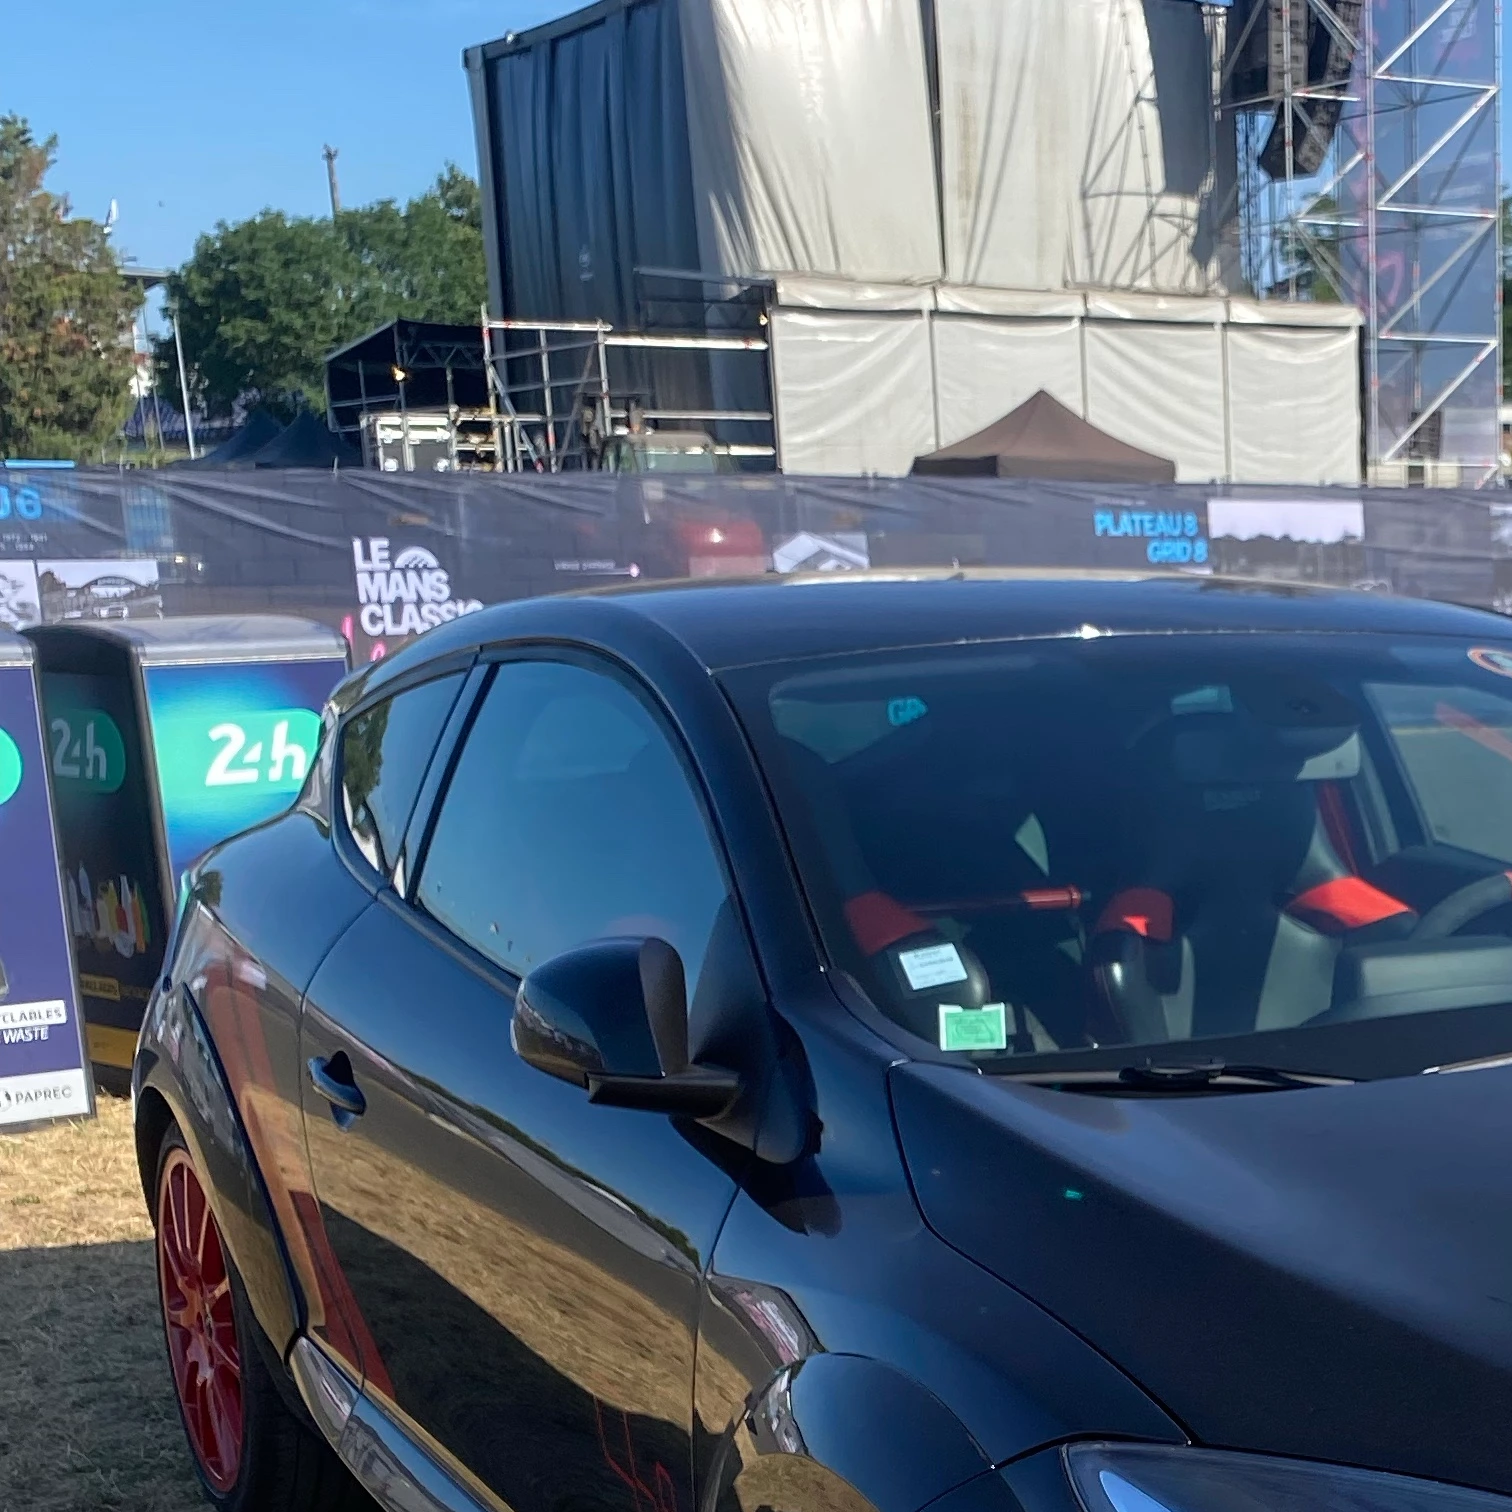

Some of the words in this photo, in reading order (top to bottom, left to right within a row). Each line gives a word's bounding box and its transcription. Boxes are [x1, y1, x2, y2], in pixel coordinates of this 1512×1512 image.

[1093, 509, 1182, 537] PLATEAU
[352, 536, 391, 571] LE
[1147, 538, 1192, 563] GRID
[356, 568, 451, 604] MANS
[205, 720, 307, 787] 24h
[3, 1025, 49, 1044] WASTE
[15, 1085, 73, 1105] PAPREC
